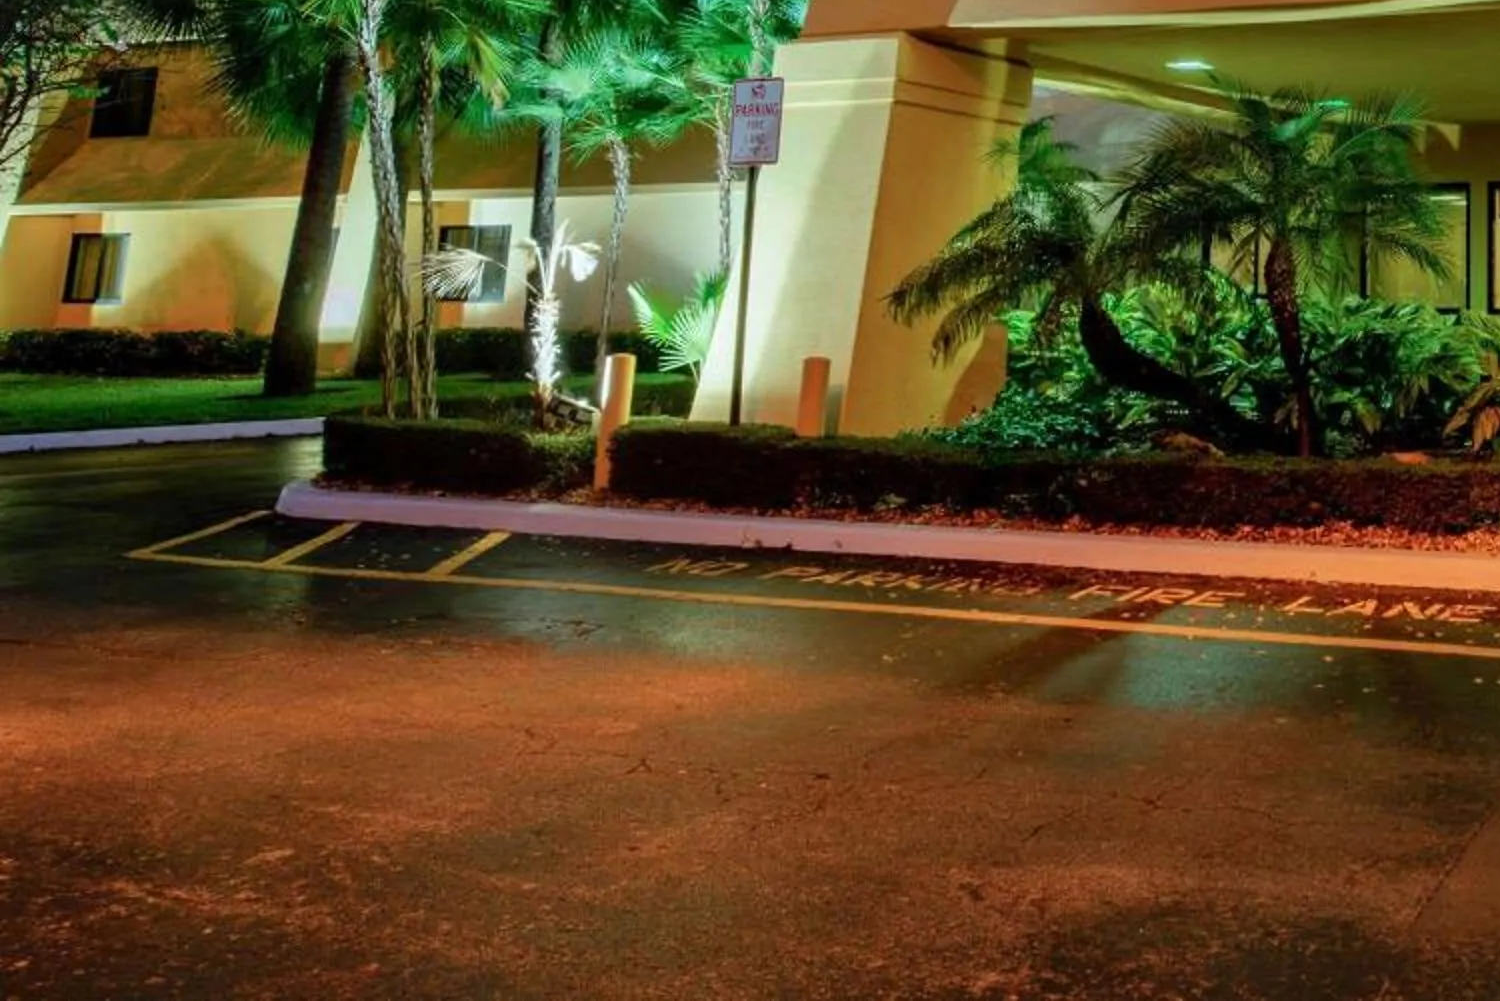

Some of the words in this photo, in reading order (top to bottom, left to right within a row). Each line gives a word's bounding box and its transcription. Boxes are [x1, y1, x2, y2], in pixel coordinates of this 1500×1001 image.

[736, 102, 780, 117] PARKING
[1069, 585, 1247, 607] FIRE
[1279, 596, 1497, 622] LANE
